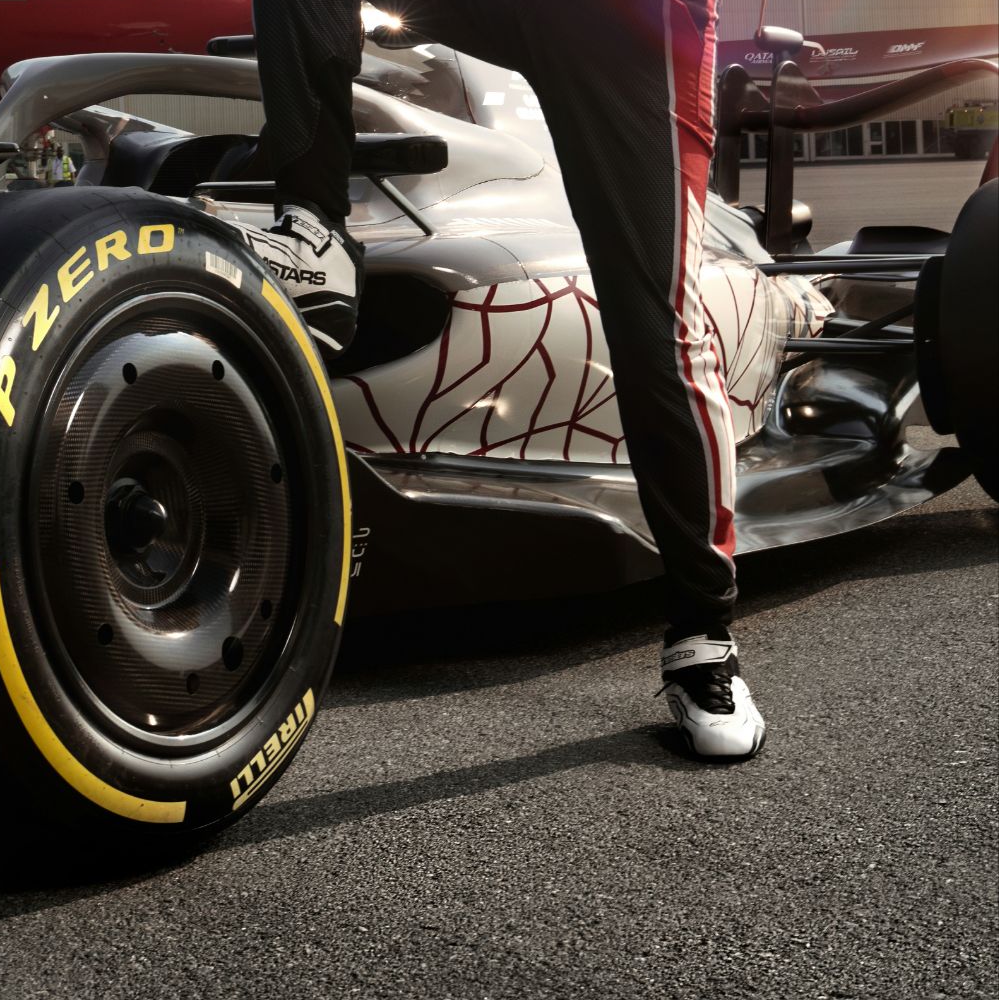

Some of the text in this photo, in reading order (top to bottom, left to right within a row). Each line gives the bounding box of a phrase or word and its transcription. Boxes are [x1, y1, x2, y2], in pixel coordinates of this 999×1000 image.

[744, 53, 774, 61] QATA
[22, 223, 175, 351] ZERO
[262, 256, 327, 286] STARS
[230, 687, 315, 811] PIRELLI
